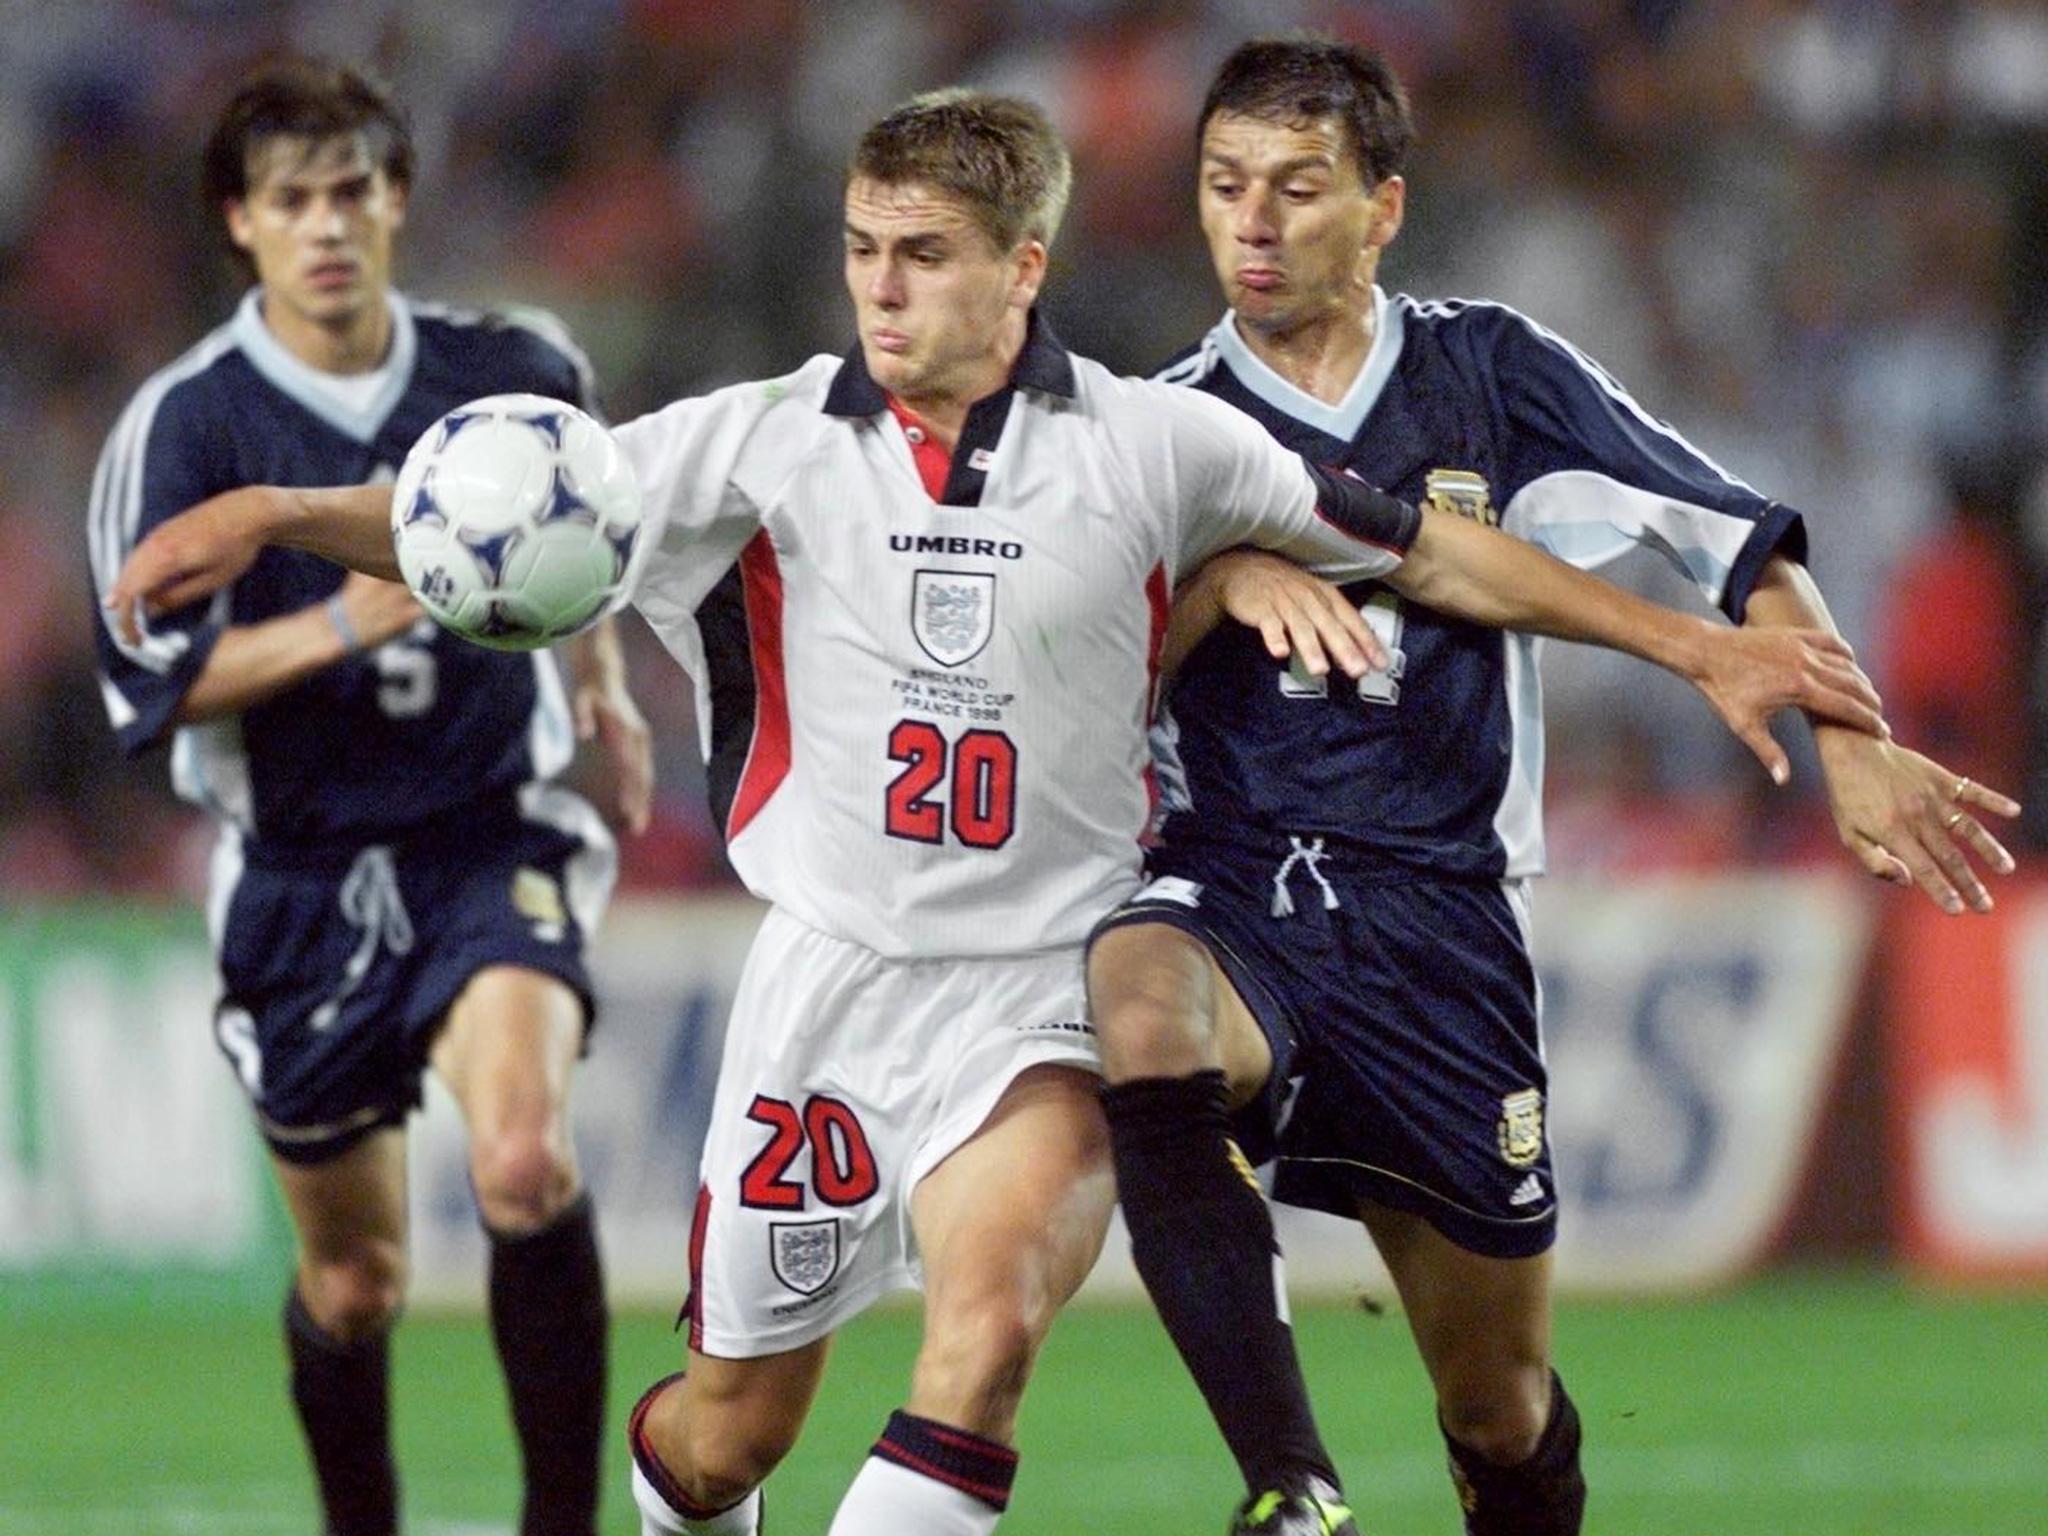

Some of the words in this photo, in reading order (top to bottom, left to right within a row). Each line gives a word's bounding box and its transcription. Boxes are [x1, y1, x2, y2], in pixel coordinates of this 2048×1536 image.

[889, 534, 1023, 560] UMBRO
[376, 621, 438, 719] 5
[910, 669, 988, 690] ENGLAND
[892, 679, 920, 694] FIFA
[928, 686, 979, 704] WORLD
[983, 693, 1015, 707] CUP
[904, 696, 961, 717] FRANCE
[885, 719, 1018, 851] 20
[740, 1093, 880, 1212] 20
